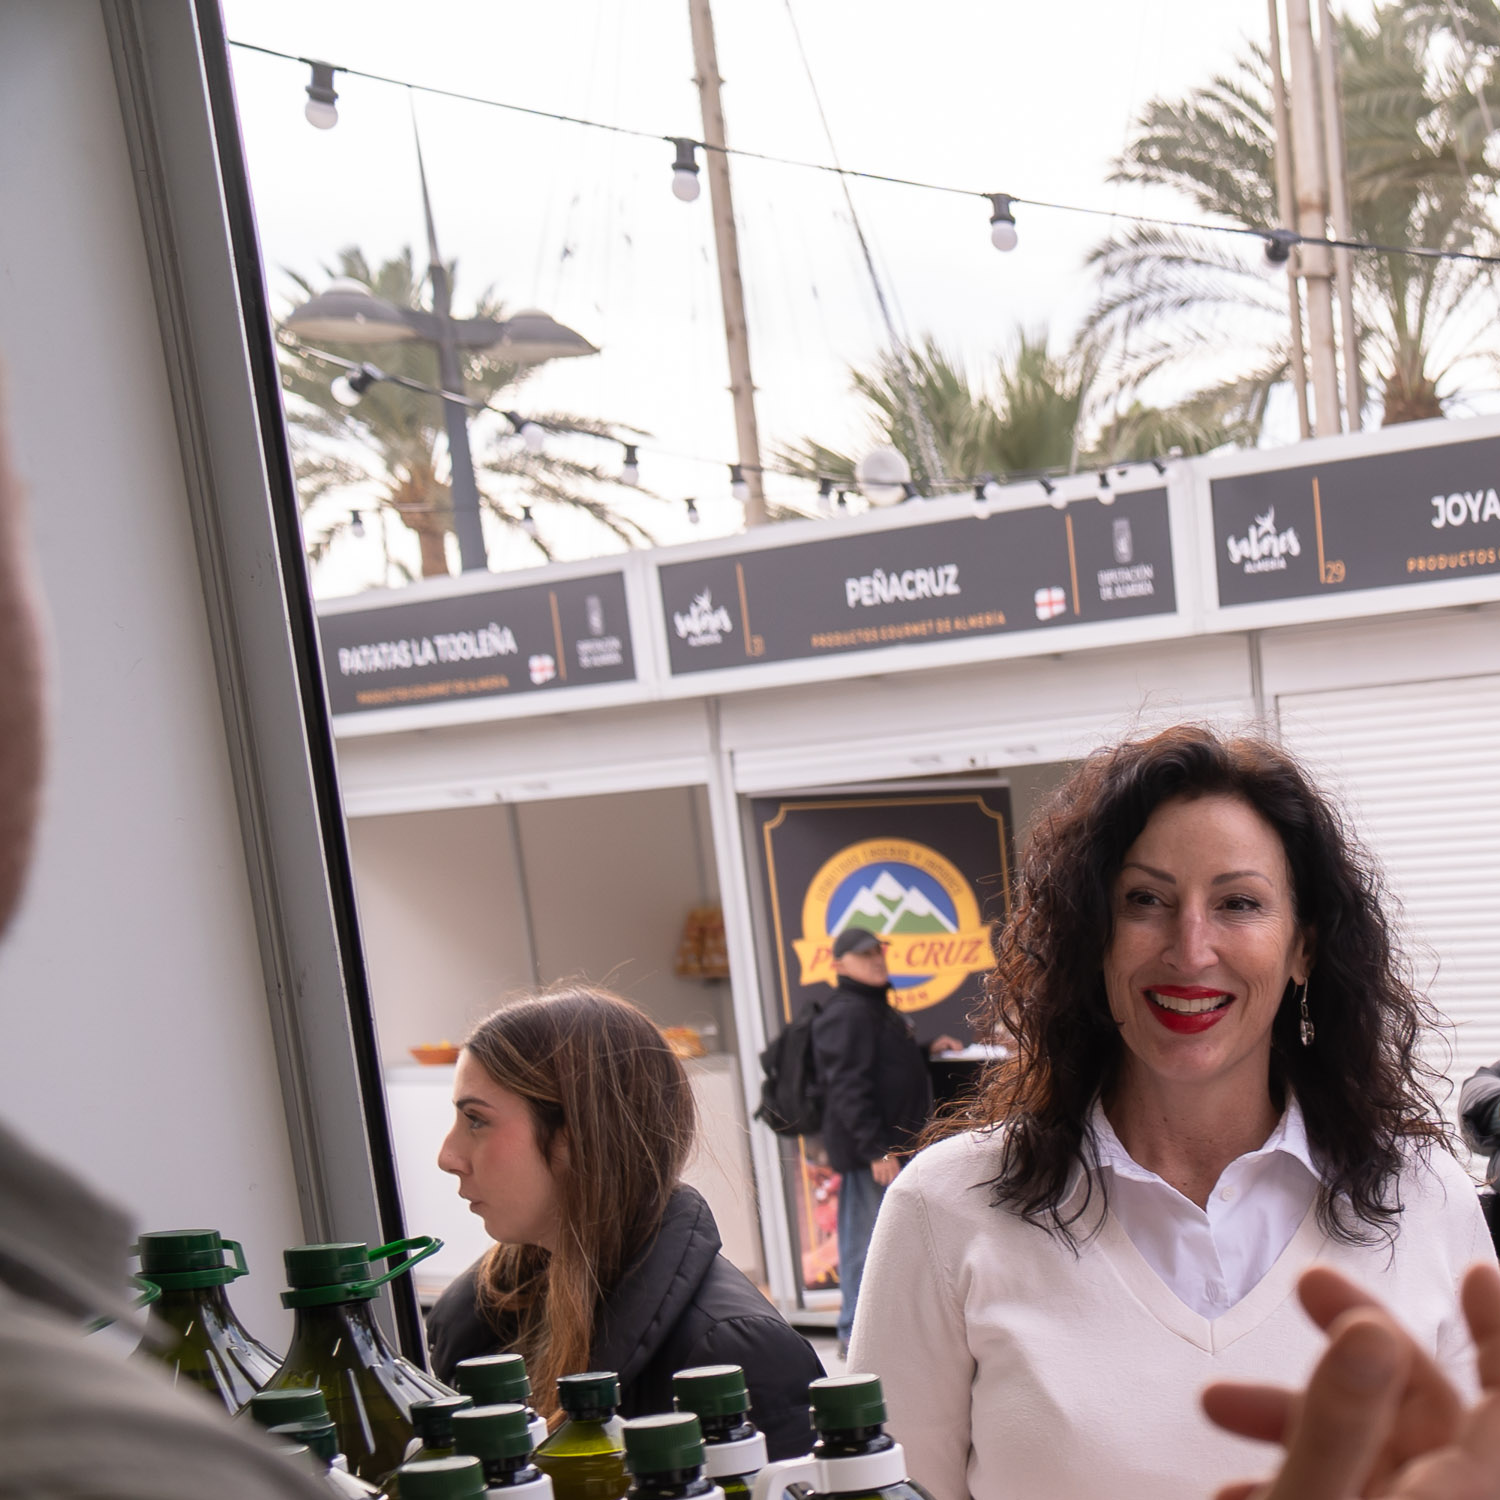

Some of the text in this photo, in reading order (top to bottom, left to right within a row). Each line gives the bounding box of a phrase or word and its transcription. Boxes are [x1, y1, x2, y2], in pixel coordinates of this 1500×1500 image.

[1325, 560, 1346, 584] 29
[1406, 548, 1496, 574] PRODUCTOS
[845, 563, 961, 608] PEÑACRUZ
[905, 939, 983, 968] CRUZ
